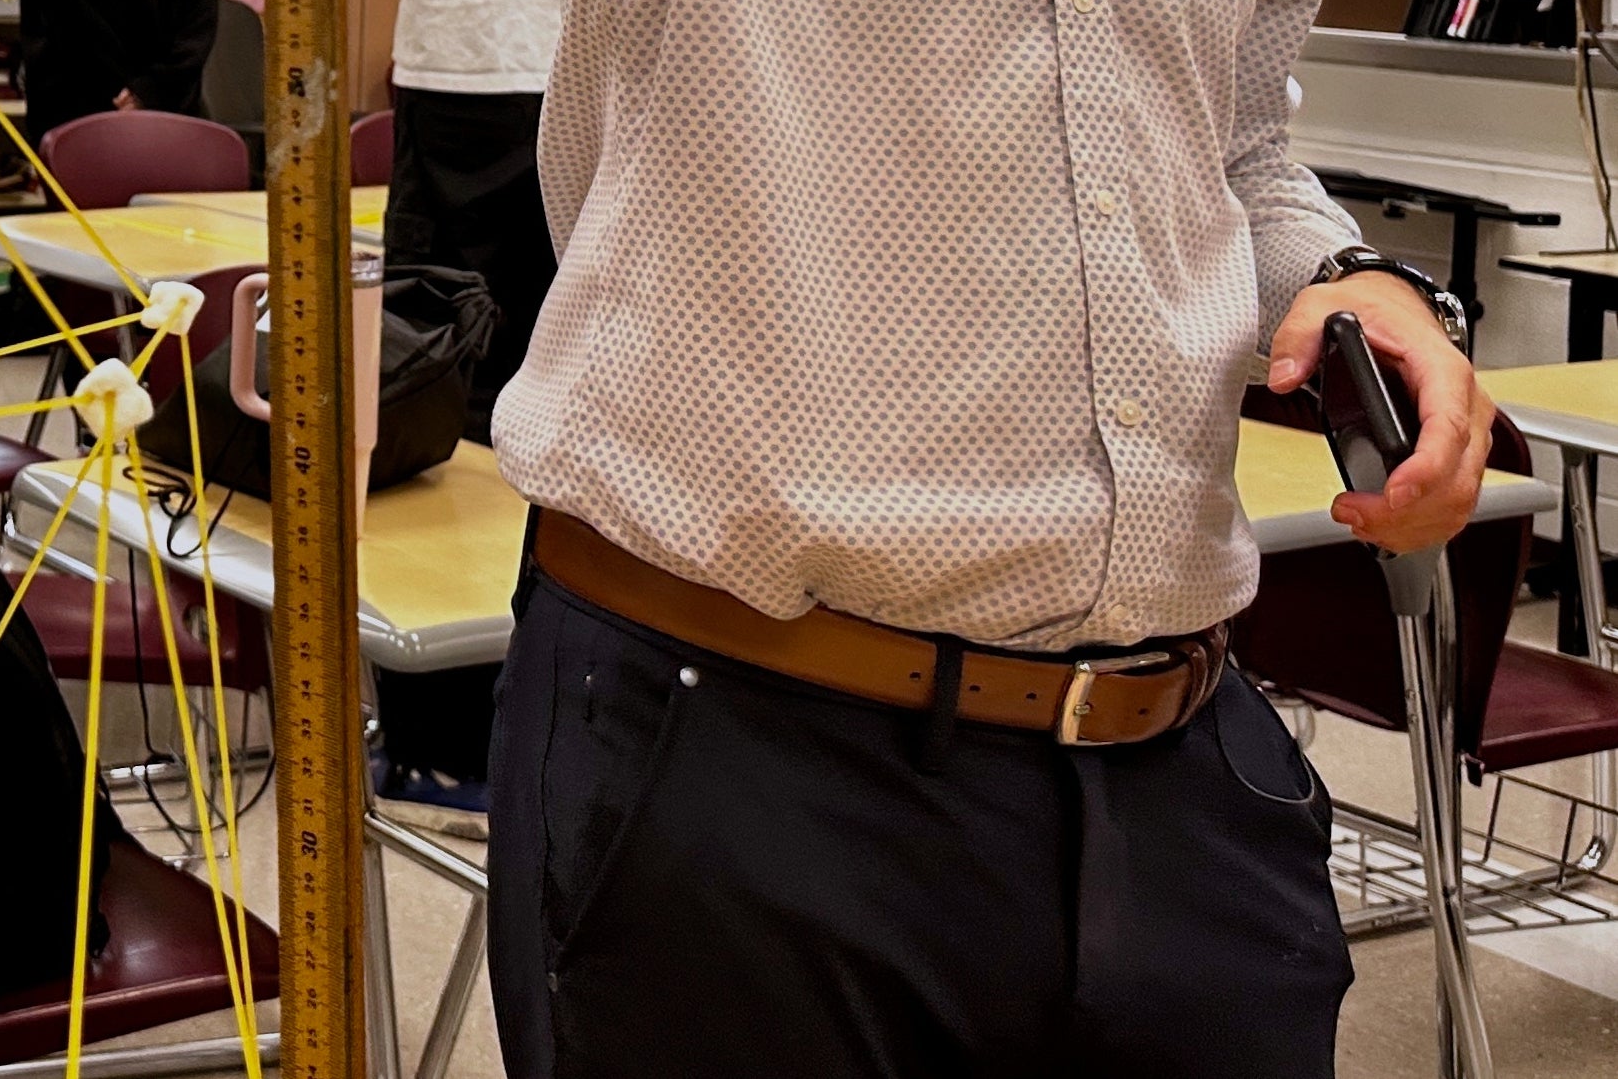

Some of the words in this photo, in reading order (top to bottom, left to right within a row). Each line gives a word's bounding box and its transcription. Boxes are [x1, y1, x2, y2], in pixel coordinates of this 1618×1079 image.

[291, 185, 302, 205] 47
[293, 223, 303, 243] 46
[293, 260, 304, 280] 45
[294, 299, 305, 320] 44
[295, 336, 305, 357] 43
[295, 374, 305, 395] 42
[295, 412, 306, 430] 41
[294, 446, 311, 475] 40
[298, 488, 308, 508] 39
[298, 526, 309, 546] 38
[298, 565, 309, 584] 37
[299, 602, 310, 622] 36
[300, 642, 310, 662] 35
[301, 679, 311, 700] 34
[301, 718, 312, 740] 33
[302, 757, 313, 778] 32
[303, 798, 313, 816] 31
[301, 830, 318, 860] 30
[305, 872, 315, 894] 29
[305, 911, 316, 931] 28
[305, 949, 316, 970] 27
[306, 988, 317, 1009] 26
[307, 1028, 317, 1048] 25
